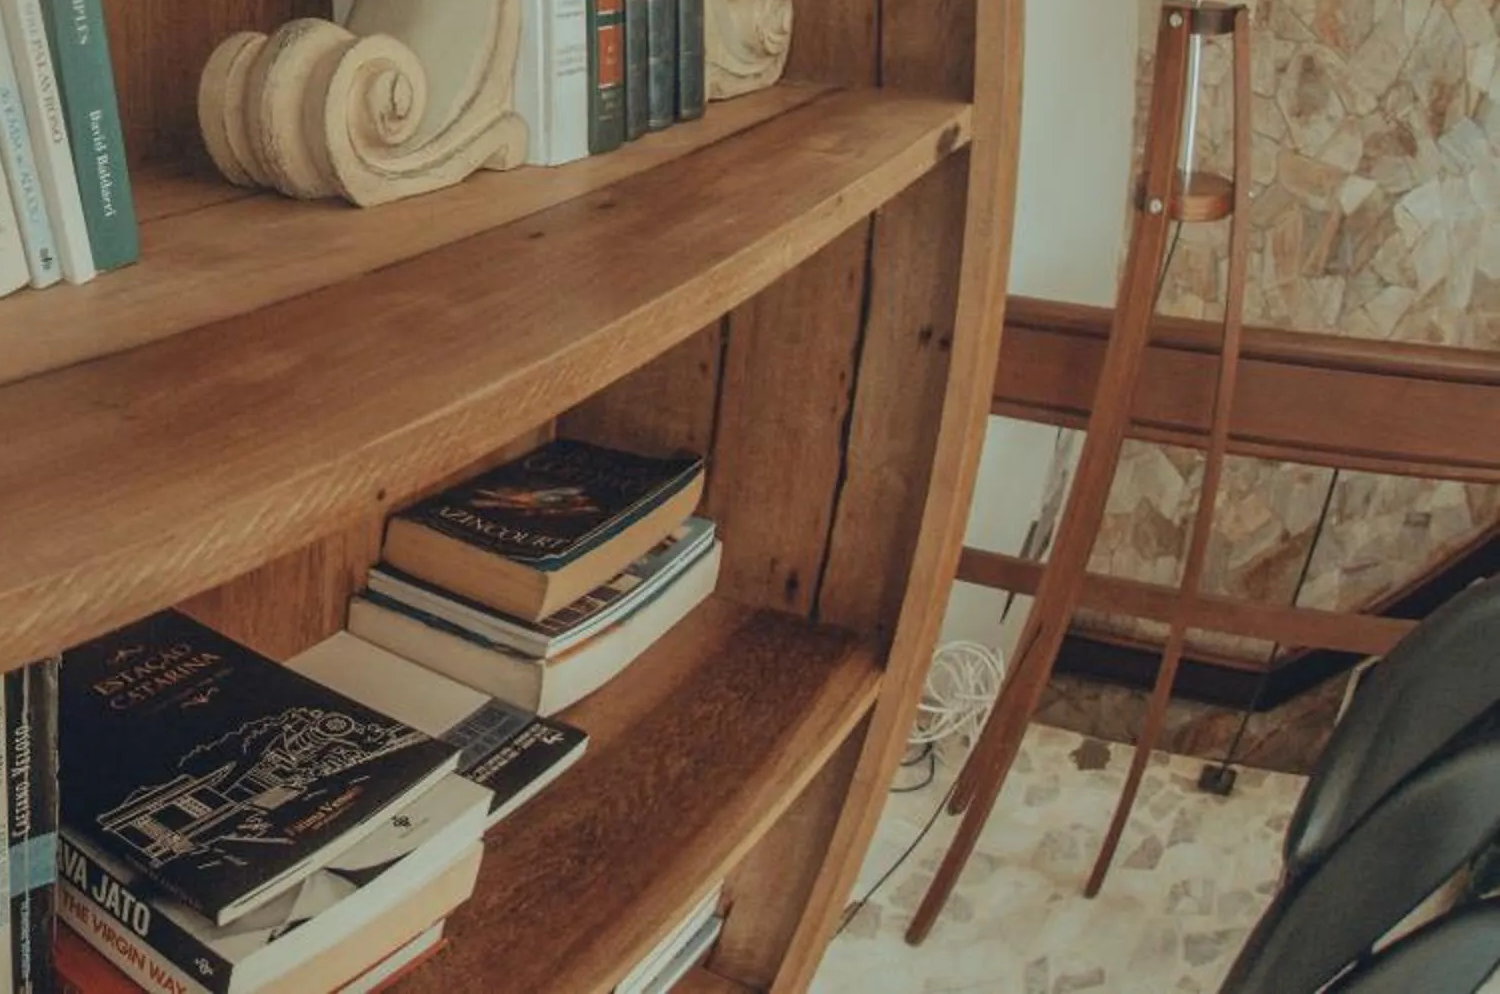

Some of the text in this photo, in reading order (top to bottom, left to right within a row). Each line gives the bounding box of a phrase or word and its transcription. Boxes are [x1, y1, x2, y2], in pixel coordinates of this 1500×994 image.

[63, 890, 188, 994] THE VIRGIN WAY
[92, 874, 150, 937] JATO
